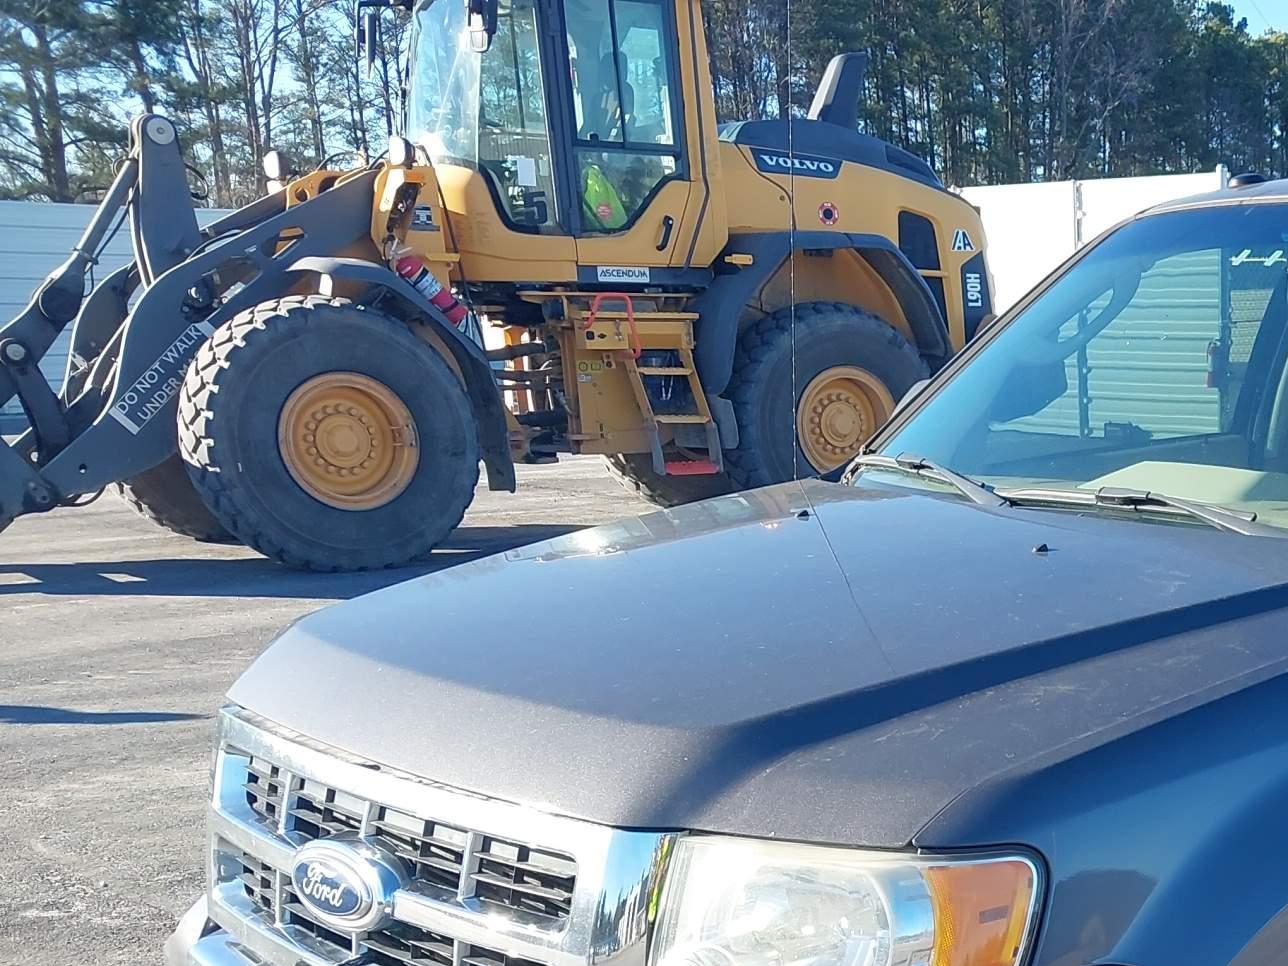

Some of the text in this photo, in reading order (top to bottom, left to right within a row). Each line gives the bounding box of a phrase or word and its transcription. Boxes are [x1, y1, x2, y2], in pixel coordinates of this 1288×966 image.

[760, 154, 834, 172] VOLVO
[599, 268, 648, 279] ASCENDUM
[966, 273, 982, 306] L90H
[116, 392, 138, 414] DO
[135, 361, 166, 393] NOT
[162, 326, 202, 364] WALK
[136, 377, 182, 420] UNDER
[303, 862, 343, 908] Ford
